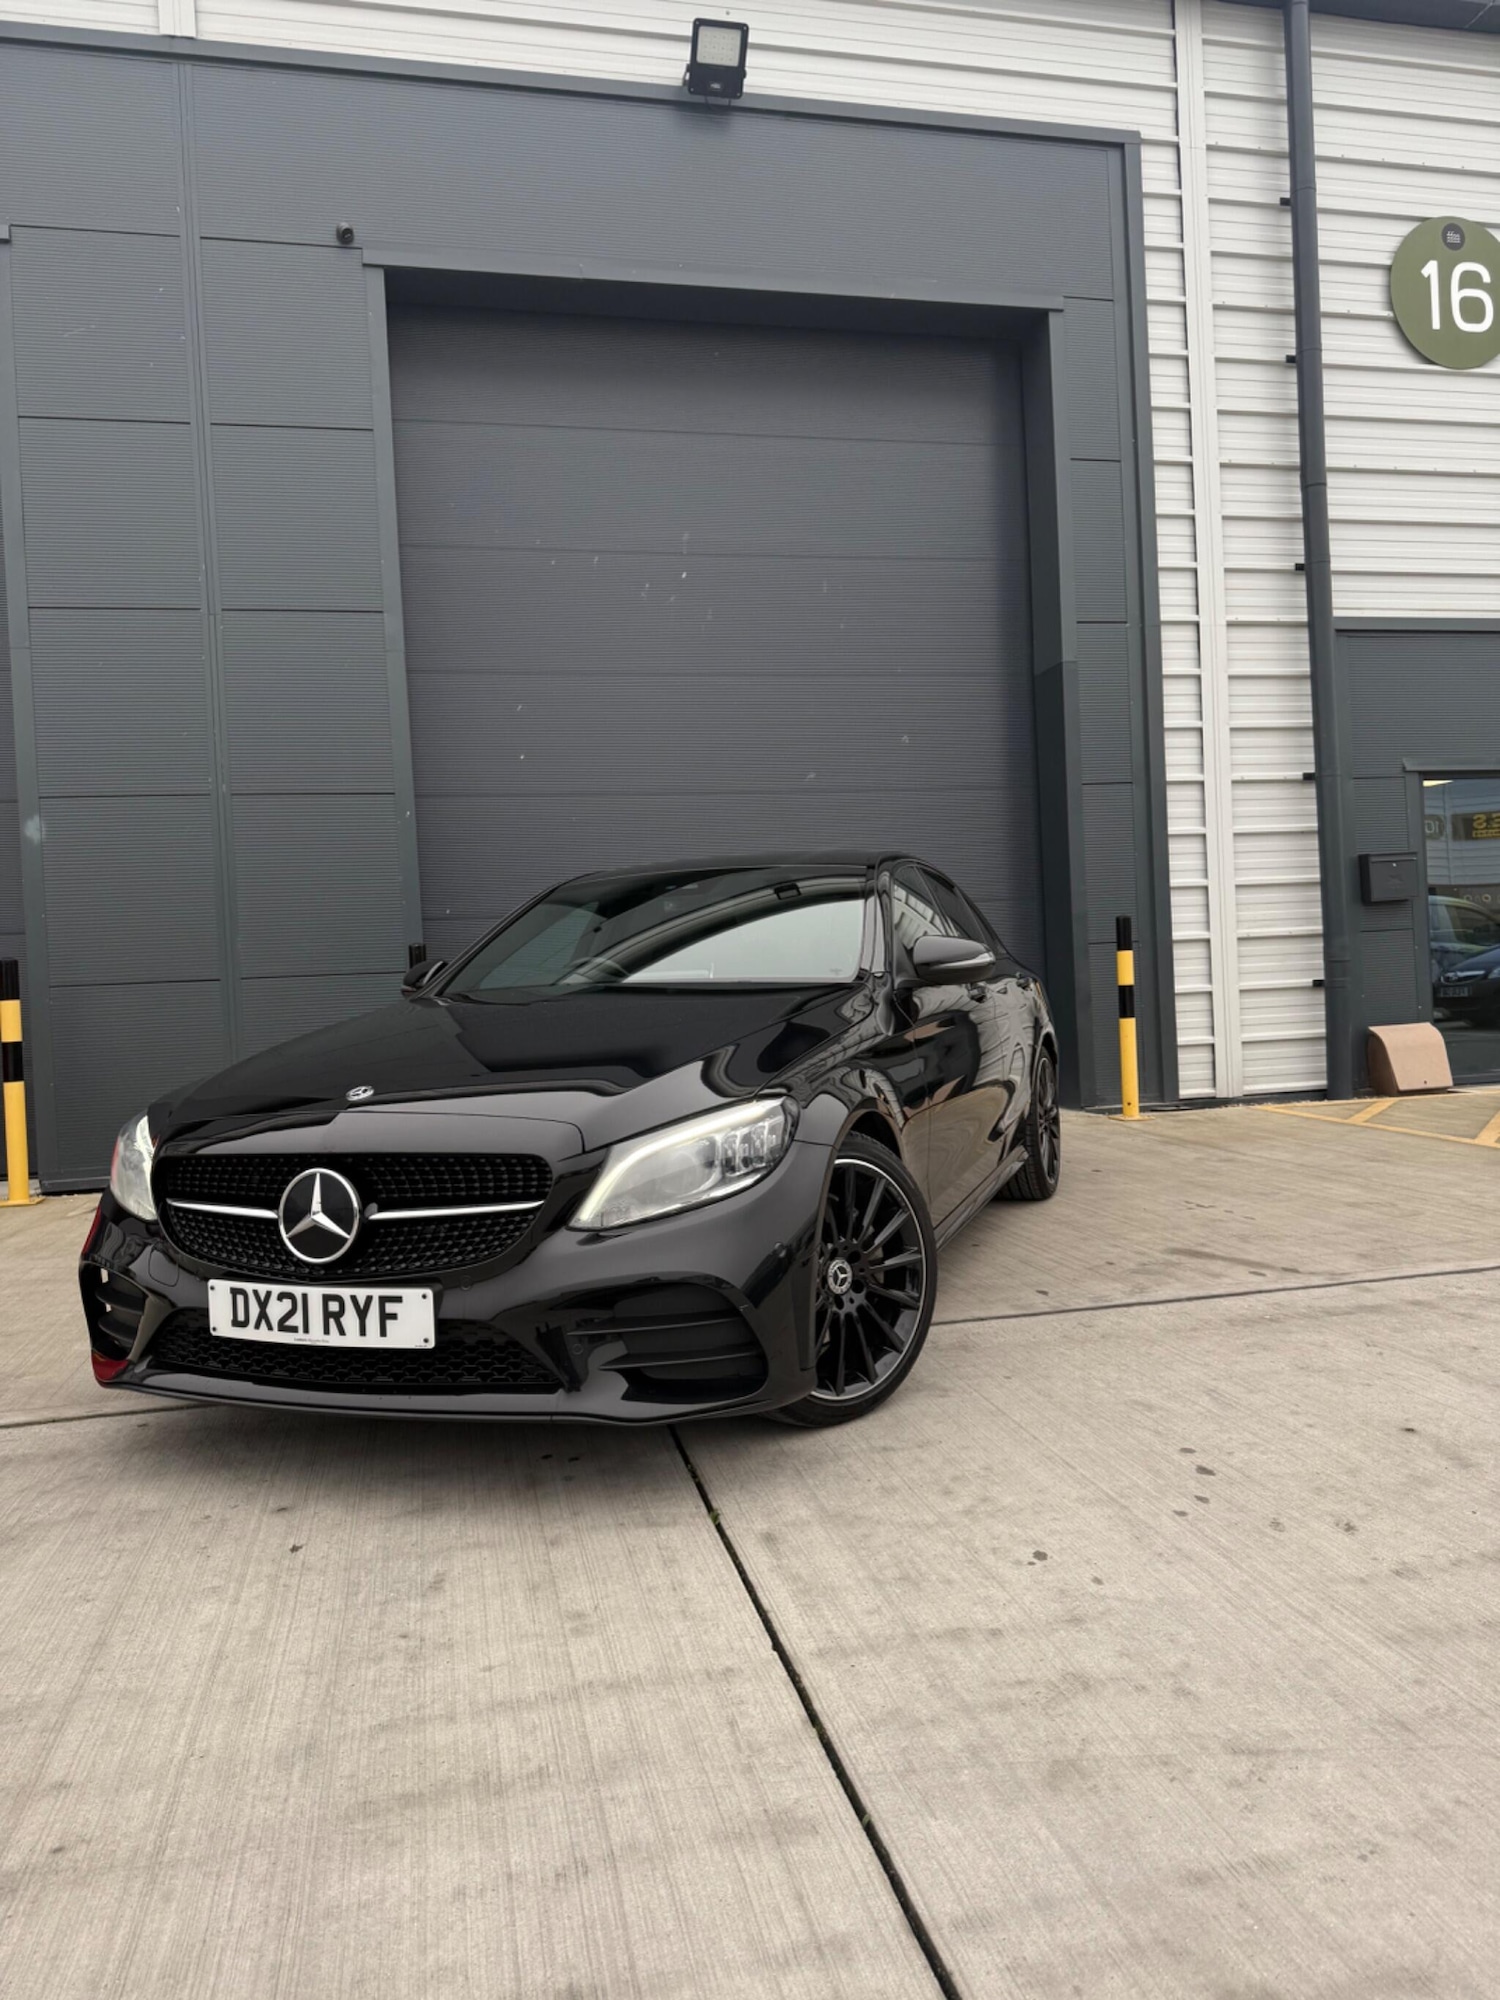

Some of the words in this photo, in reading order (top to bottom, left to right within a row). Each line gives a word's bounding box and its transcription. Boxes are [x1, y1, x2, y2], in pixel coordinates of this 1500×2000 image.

[1420, 260, 1494, 333] 16
[229, 1286, 310, 1334] DX21
[322, 1293, 403, 1338] RYF
